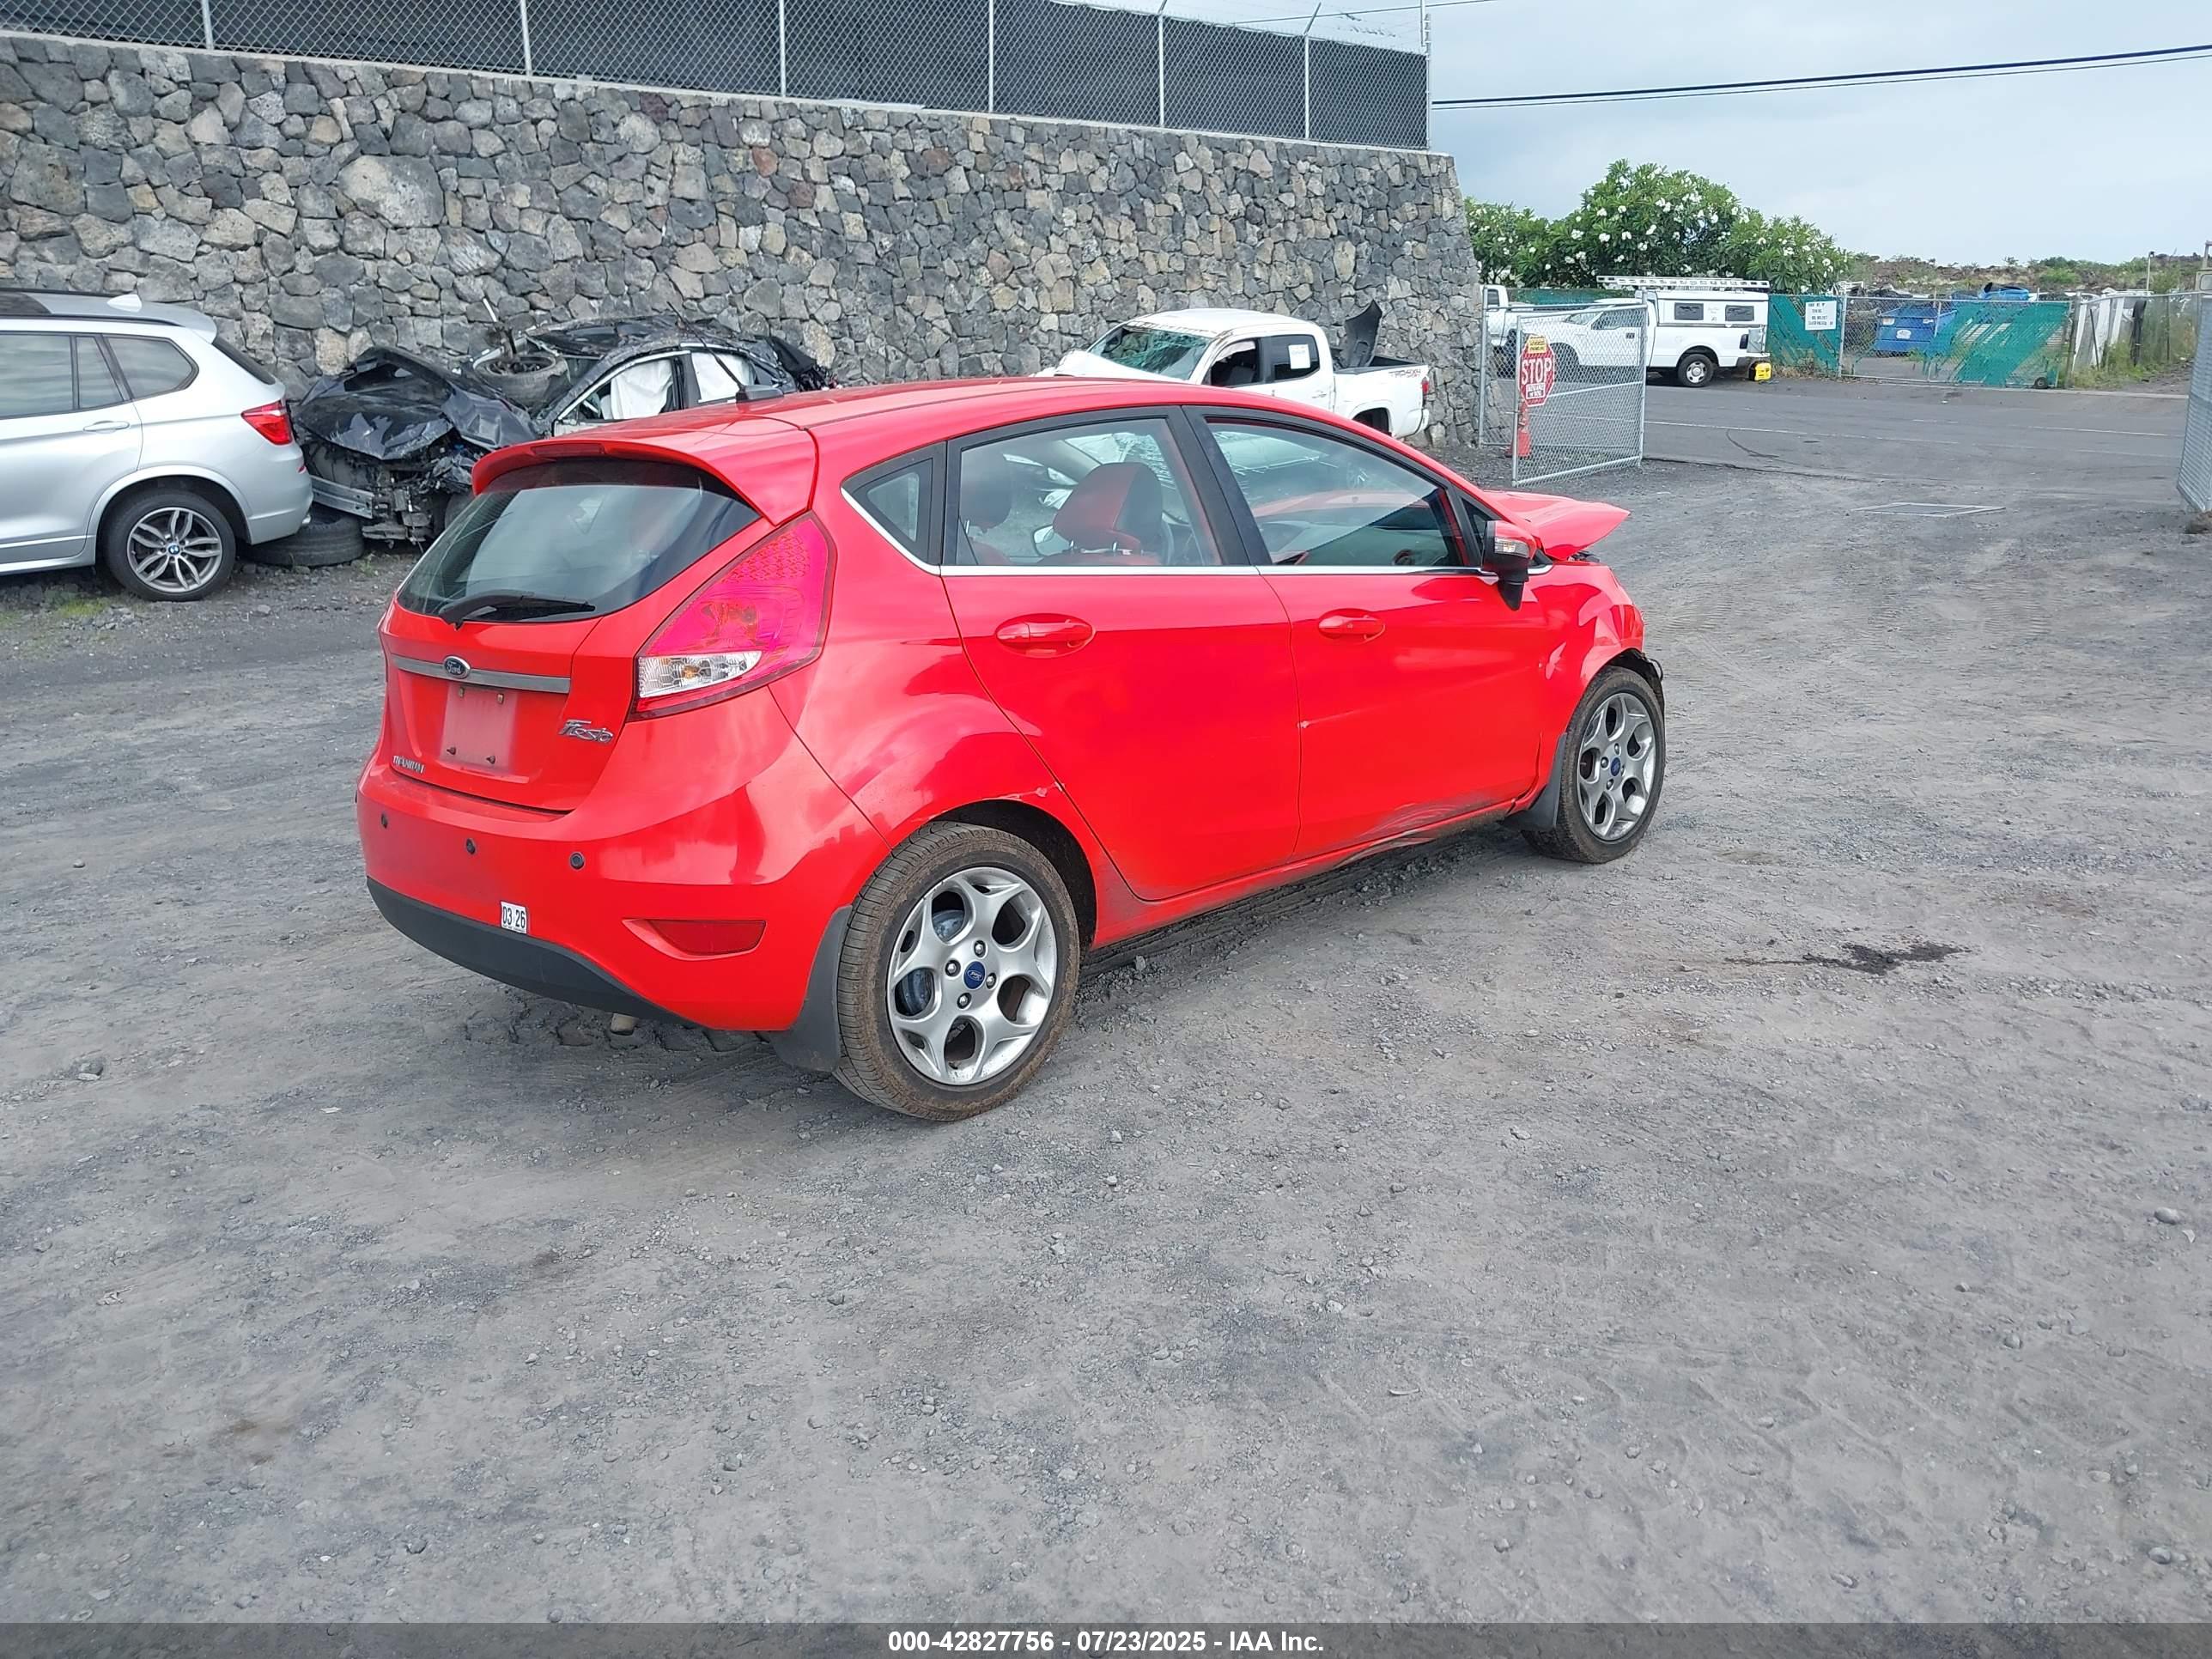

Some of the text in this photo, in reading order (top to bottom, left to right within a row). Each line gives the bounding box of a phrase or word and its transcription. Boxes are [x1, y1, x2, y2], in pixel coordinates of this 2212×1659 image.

[1521, 357, 1553, 385] STOP
[502, 906, 526, 929] 03 26
